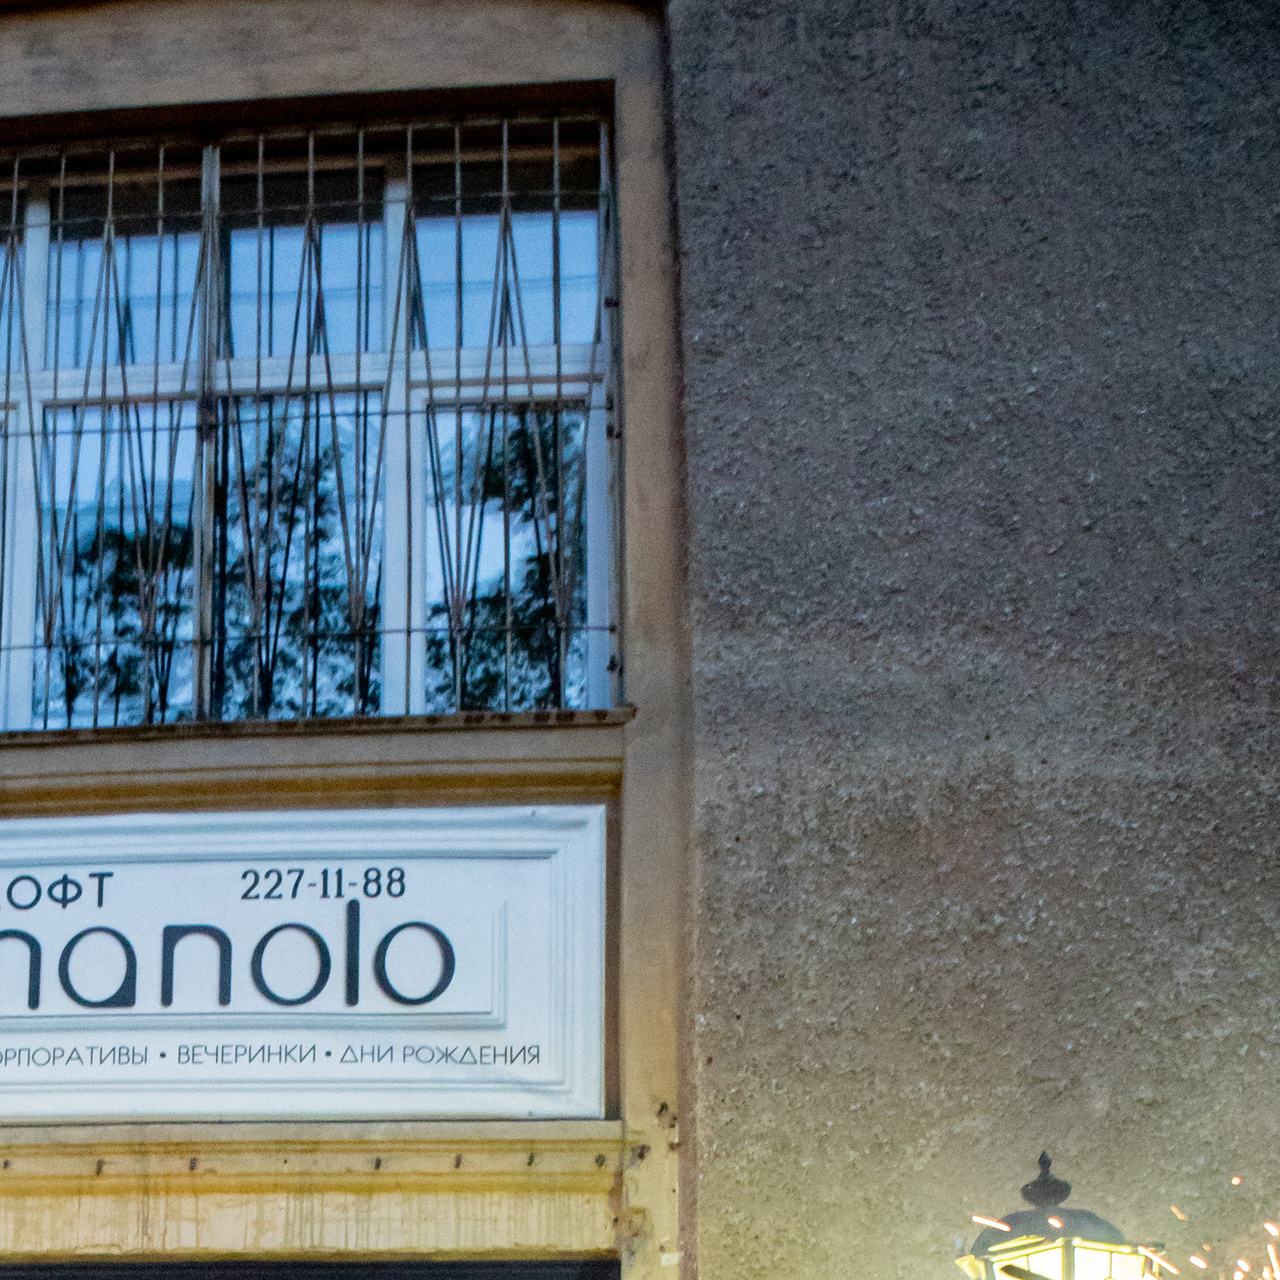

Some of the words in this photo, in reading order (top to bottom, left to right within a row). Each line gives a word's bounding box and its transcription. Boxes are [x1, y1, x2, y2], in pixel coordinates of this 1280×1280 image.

[240, 866, 406, 901] 227-11-88
[177, 1043, 317, 1065] ВЕЧЕРИНКИ
[339, 1044, 394, 1064] ДНИ
[402, 1044, 541, 1066] РОЖДЕНИЯ
